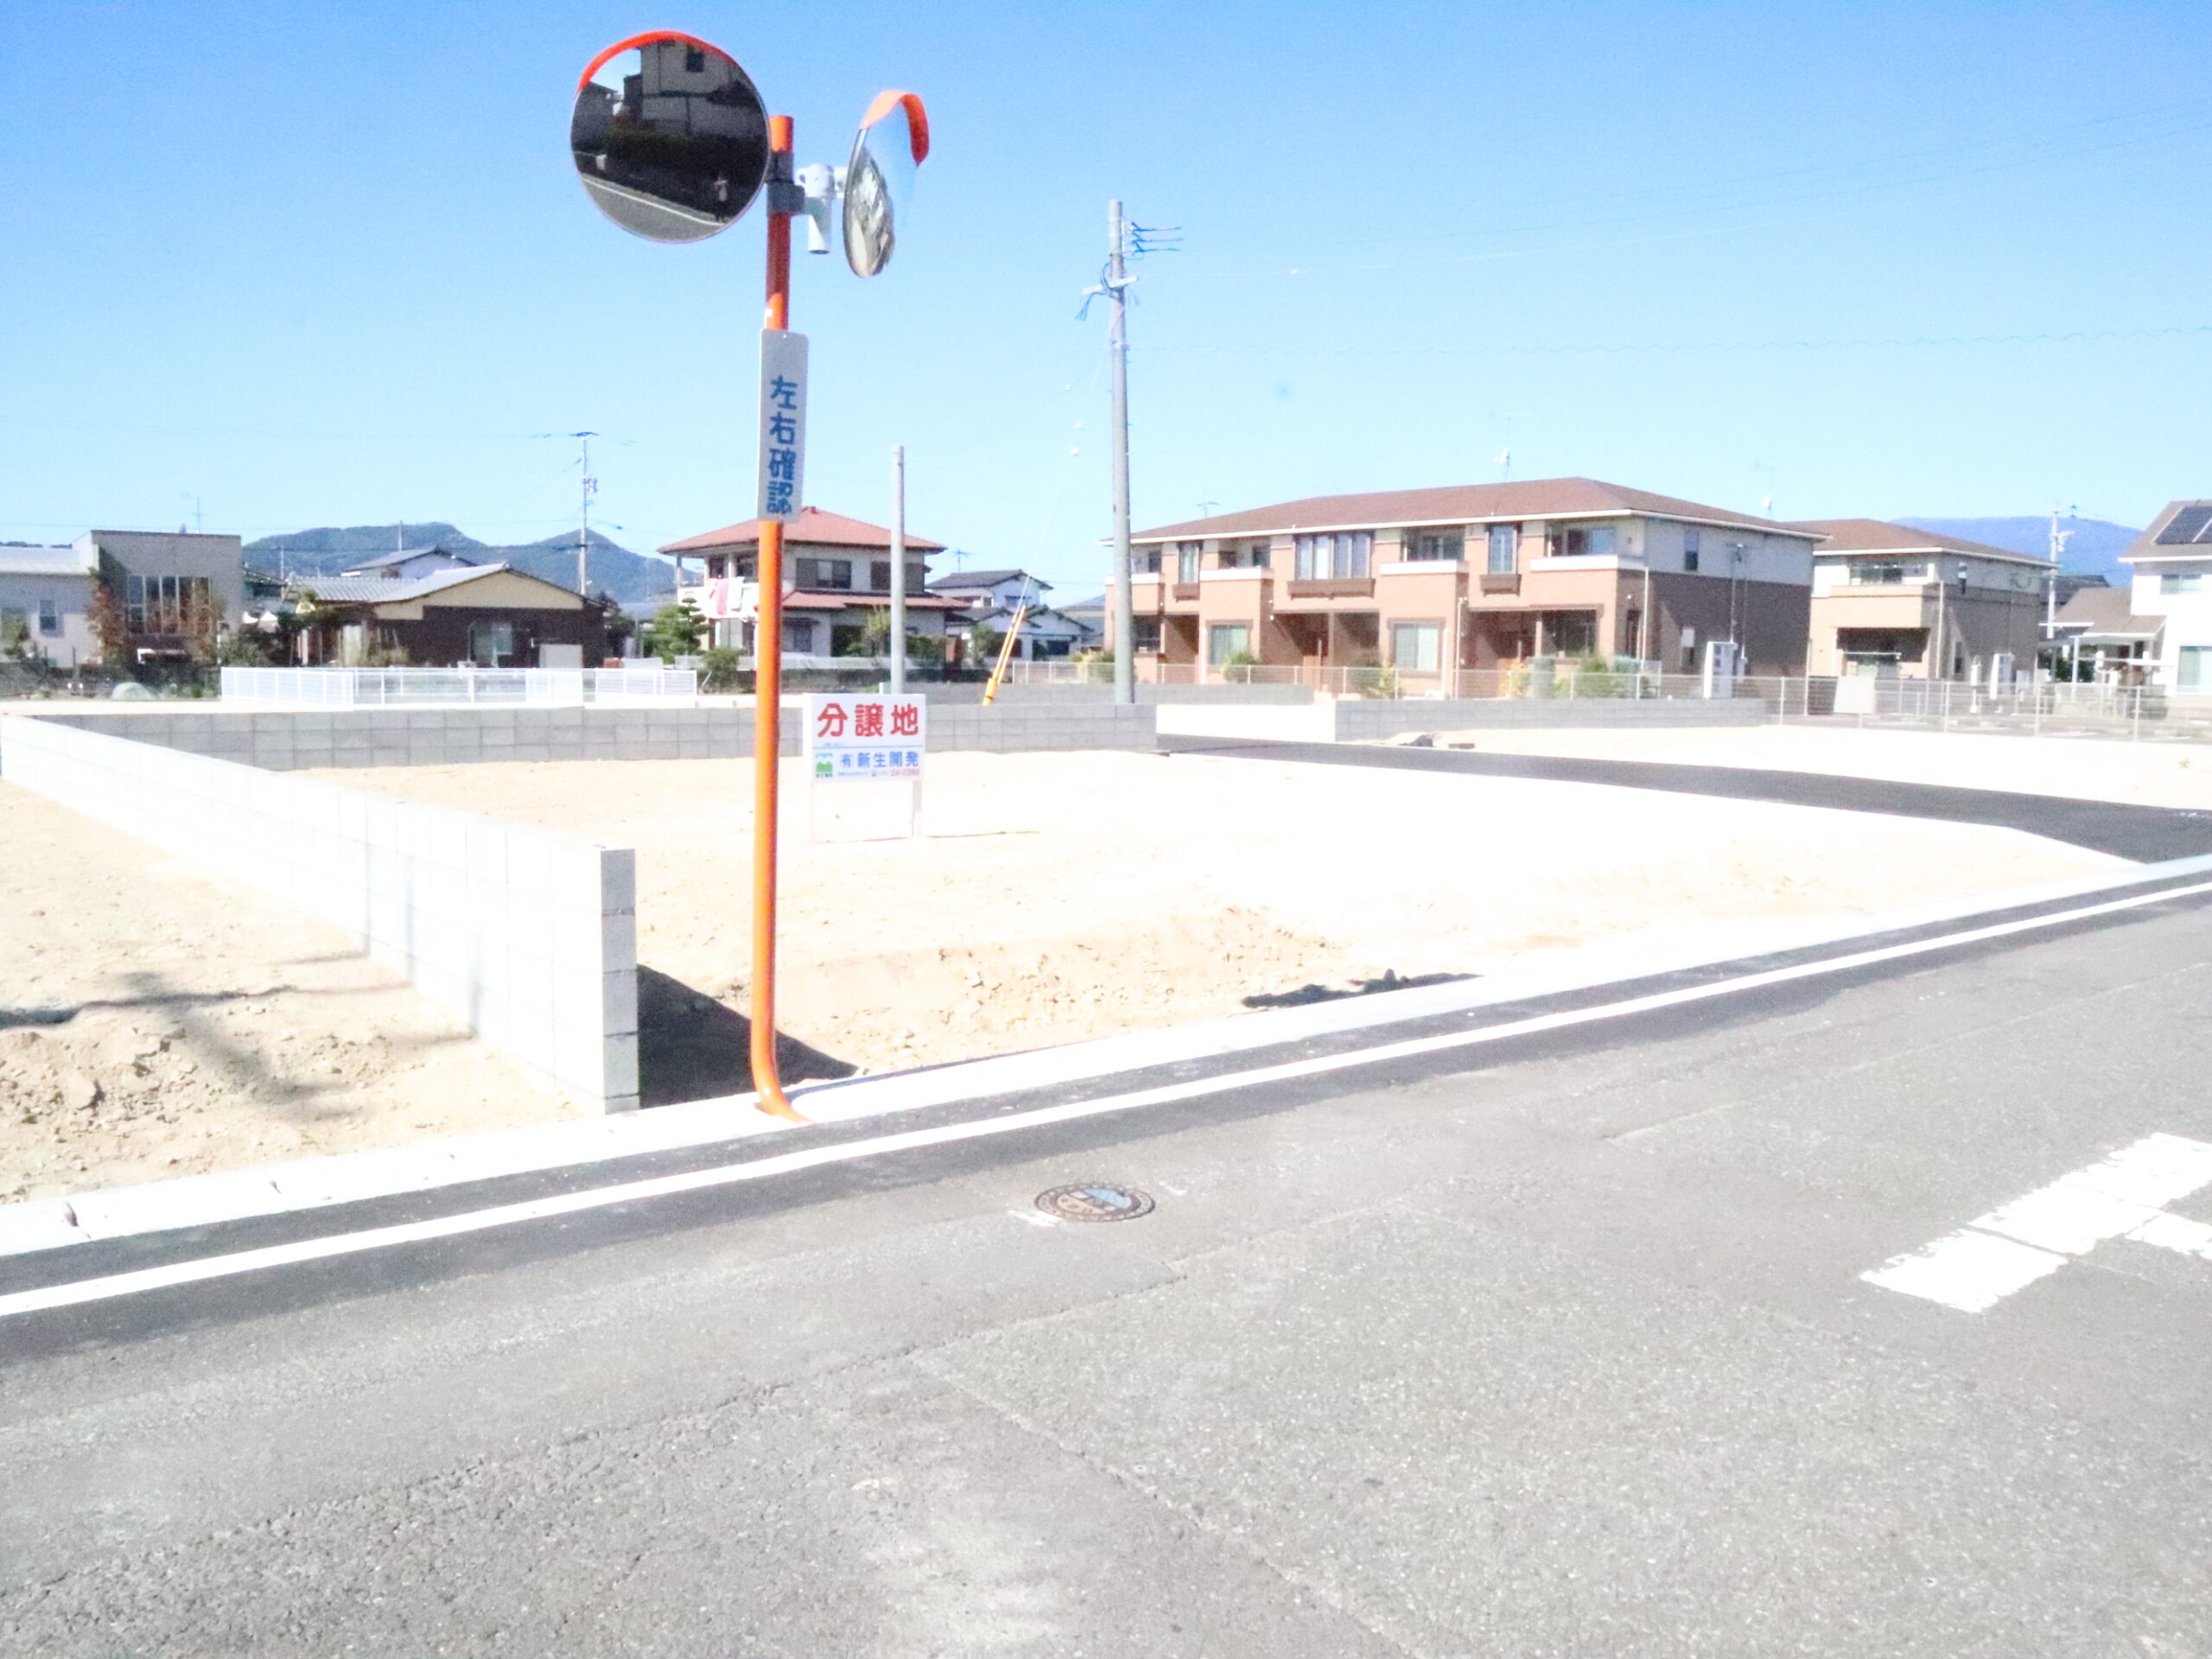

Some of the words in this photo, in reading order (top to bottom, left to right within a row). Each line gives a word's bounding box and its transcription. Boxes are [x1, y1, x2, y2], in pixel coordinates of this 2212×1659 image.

[766, 375, 798, 515] 左右確認
[817, 702, 918, 738] 分譲地
